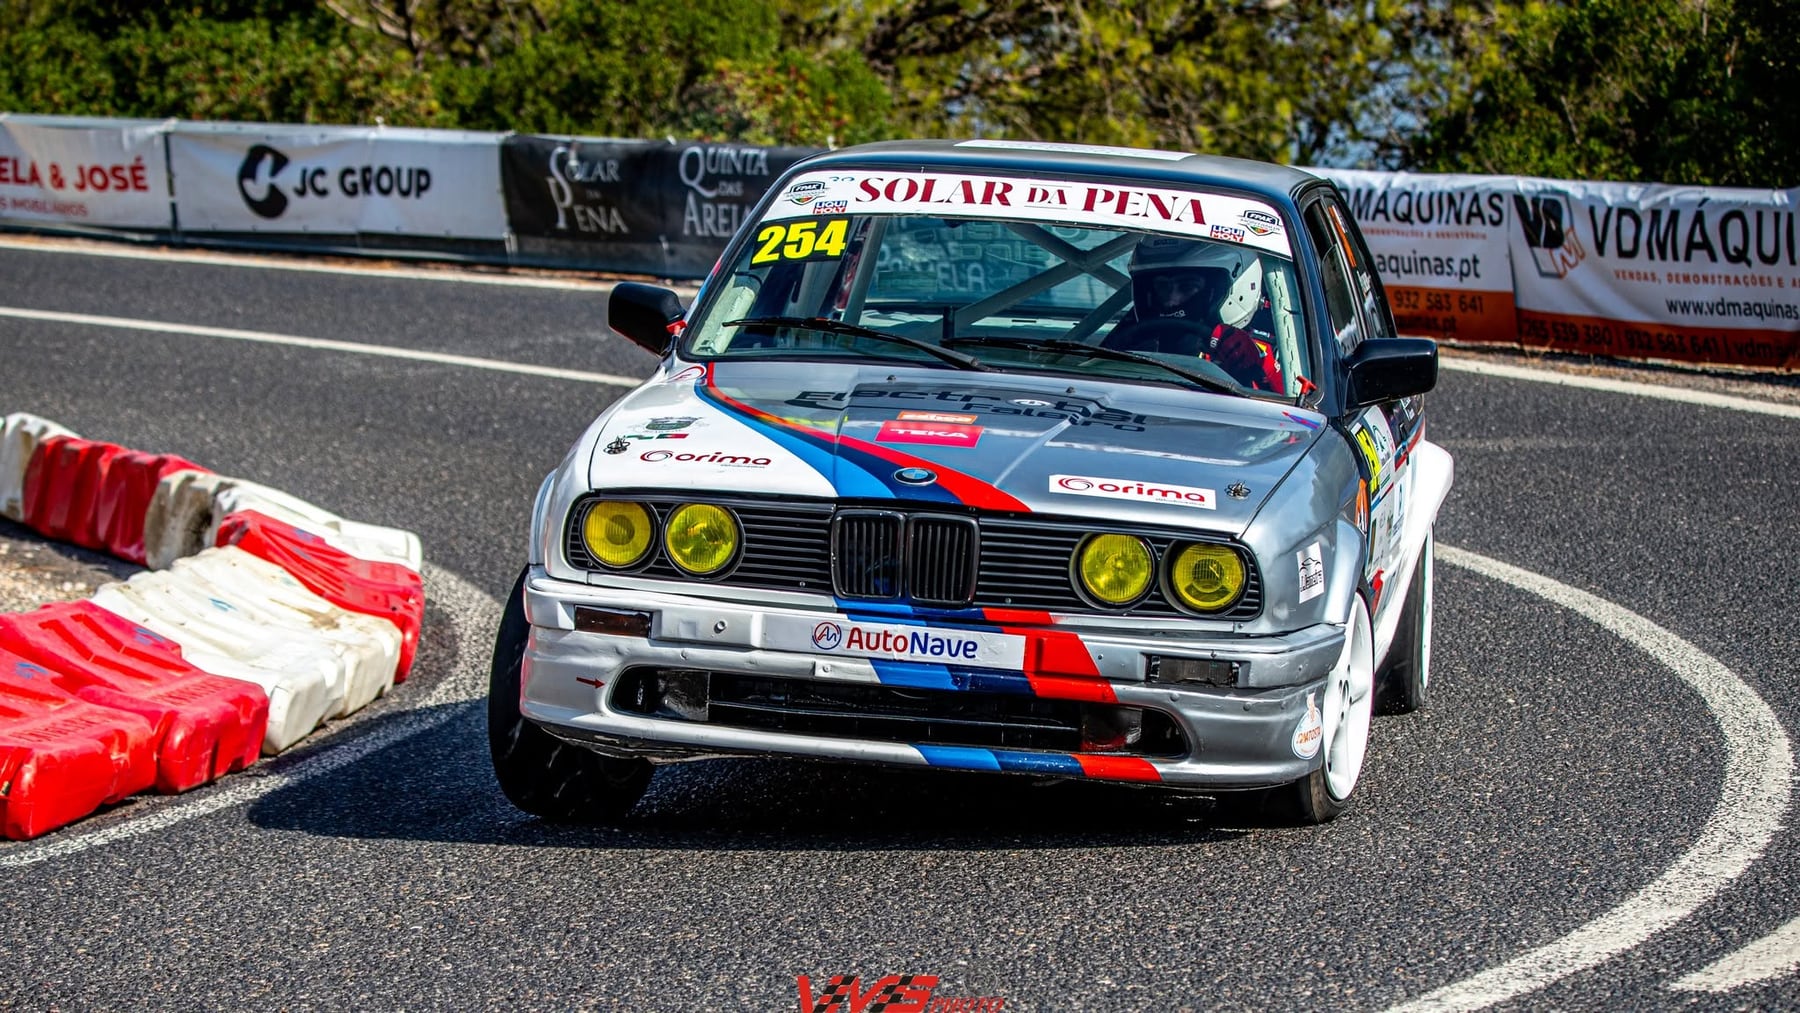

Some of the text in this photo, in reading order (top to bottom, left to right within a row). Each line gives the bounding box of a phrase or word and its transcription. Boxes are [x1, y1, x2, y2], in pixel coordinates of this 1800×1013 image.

[49, 161, 65, 191] &
[74, 155, 149, 192] JOSÉ
[293, 166, 431, 199] JC GROUP
[679, 146, 769, 197] QUINTA
[718, 181, 743, 196] DAS
[546, 177, 629, 233] PENA
[813, 207, 846, 215] MOLY
[816, 200, 848, 209] LIQUI
[855, 177, 1014, 206] SOLAR
[1027, 187, 1067, 205] DA
[1081, 187, 1207, 225] PENA
[752, 219, 848, 264] 254
[1210, 231, 1244, 243] MOLY
[1211, 224, 1245, 236] LIQUI
[1614, 269, 1662, 285] VENDAS,
[1667, 271, 1773, 288] DEMONSTRAÇÕES
[1776, 276, 1785, 288] E
[1394, 290, 1484, 314] 932 583 641
[1552, 323, 1578, 342] 539
[1584, 325, 1613, 346] 380
[1624, 329, 1652, 350] 932
[963, 402, 1146, 433] Faleiro
[891, 428, 969, 439] TEKA
[674, 452, 772, 466] orima
[1098, 483, 1206, 502] orima
[845, 626, 979, 660] AutoNave
